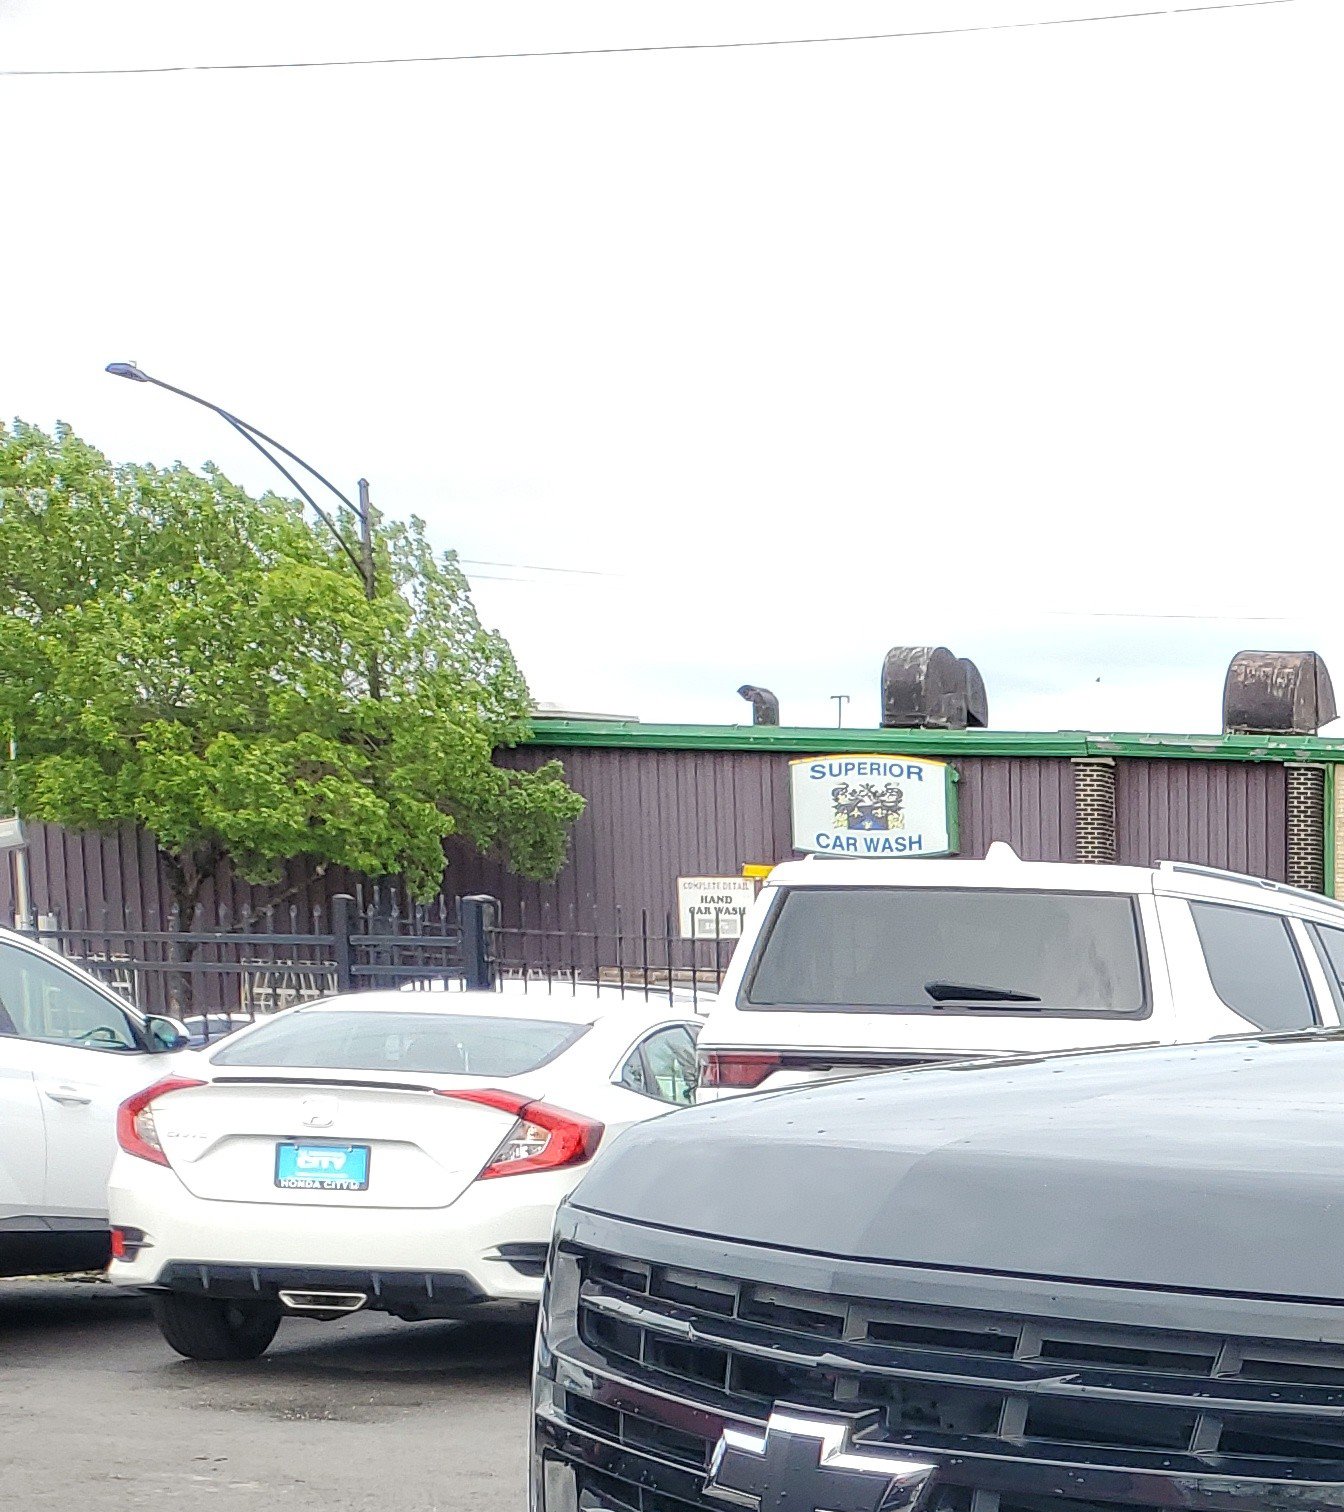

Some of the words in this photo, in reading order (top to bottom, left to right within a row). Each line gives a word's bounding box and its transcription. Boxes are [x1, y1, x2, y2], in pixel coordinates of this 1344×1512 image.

[809, 762, 924, 782] SUPERIOR
[815, 833, 858, 852] CAR
[863, 834, 923, 853] WASH
[682, 881, 720, 891] COMPLETE
[722, 881, 750, 891] DETAIL
[700, 895, 733, 904] HAND
[688, 906, 712, 916] CAR
[714, 906, 747, 916] WASH
[280, 1179, 320, 1188] HONDA
[323, 1180, 349, 1190] CITY
